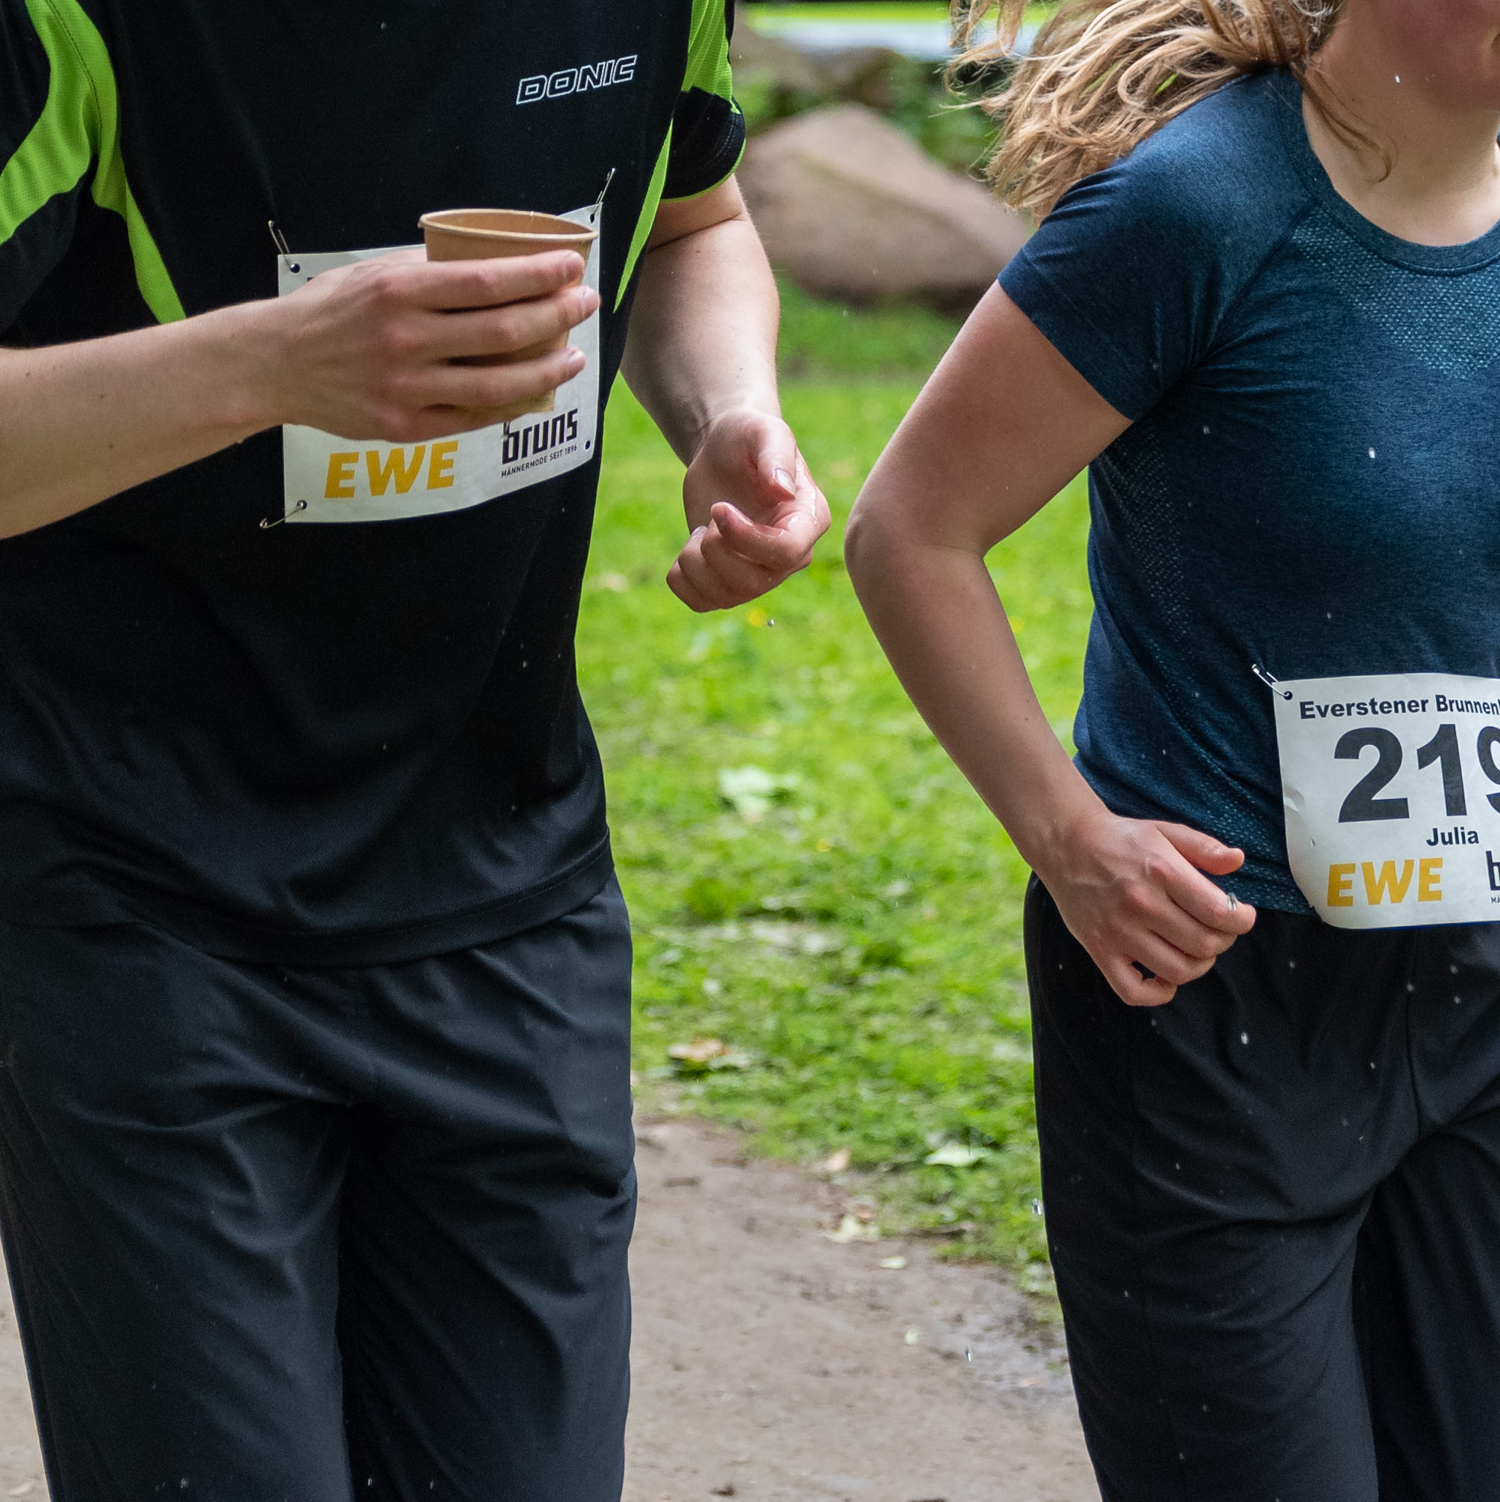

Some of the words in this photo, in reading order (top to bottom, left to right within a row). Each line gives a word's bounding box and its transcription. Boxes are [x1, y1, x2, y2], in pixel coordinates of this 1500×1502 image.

[516, 54, 638, 105] DONIC
[502, 408, 578, 465] bruns
[325, 441, 459, 499] EWE
[501, 456, 548, 478] MÄNNERMODE
[549, 450, 563, 461] SEIT
[1300, 697, 1429, 719] Everstener
[1426, 828, 1479, 846] Julia
[1326, 857, 1443, 907] EWE
